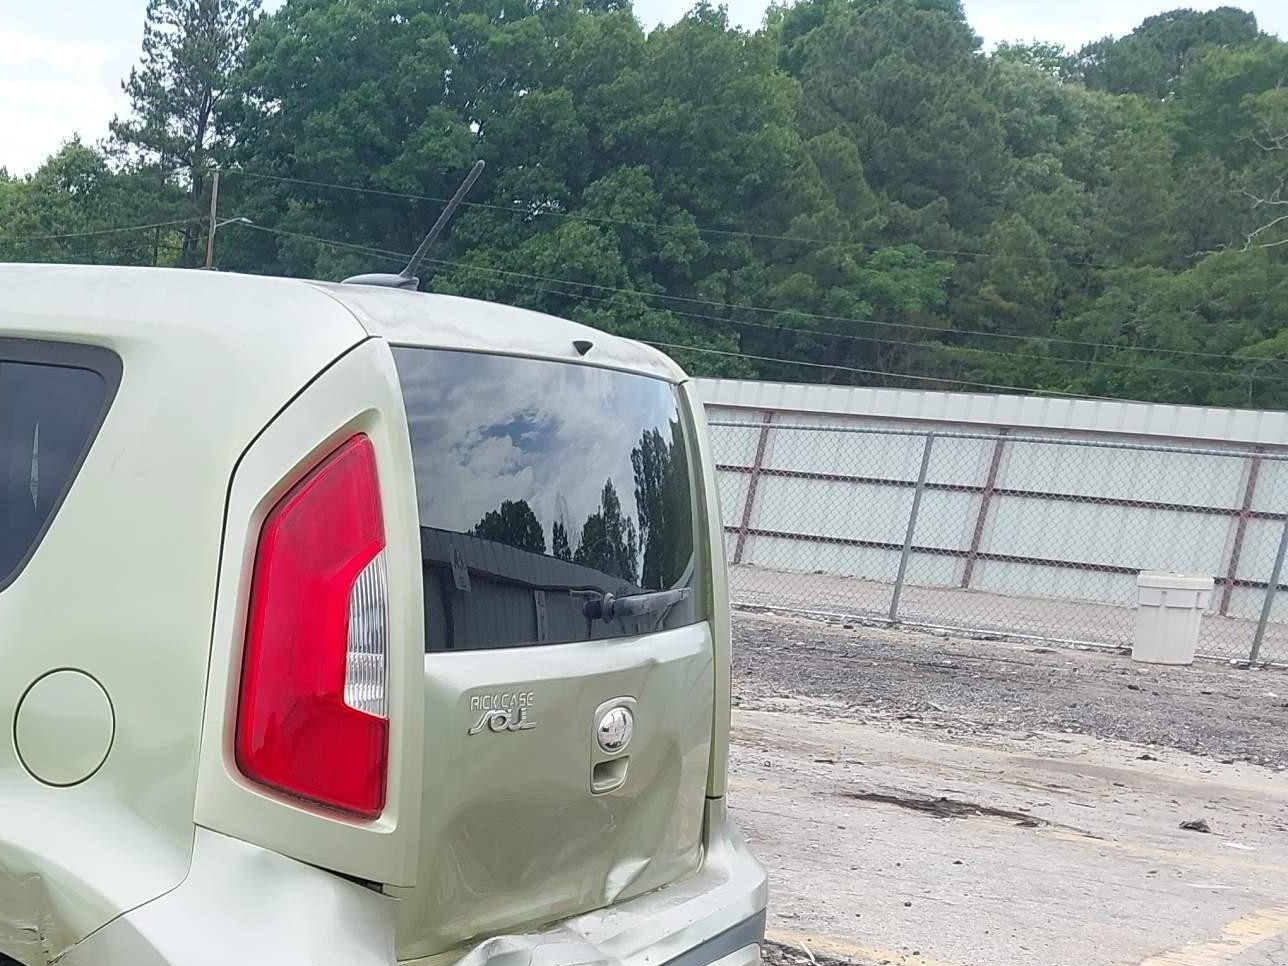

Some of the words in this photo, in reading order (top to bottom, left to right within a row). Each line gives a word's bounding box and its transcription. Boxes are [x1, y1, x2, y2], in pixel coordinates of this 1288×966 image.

[470, 695, 498, 711] RICK
[501, 692, 534, 708] CASE
[468, 707, 537, 735] SOUL
